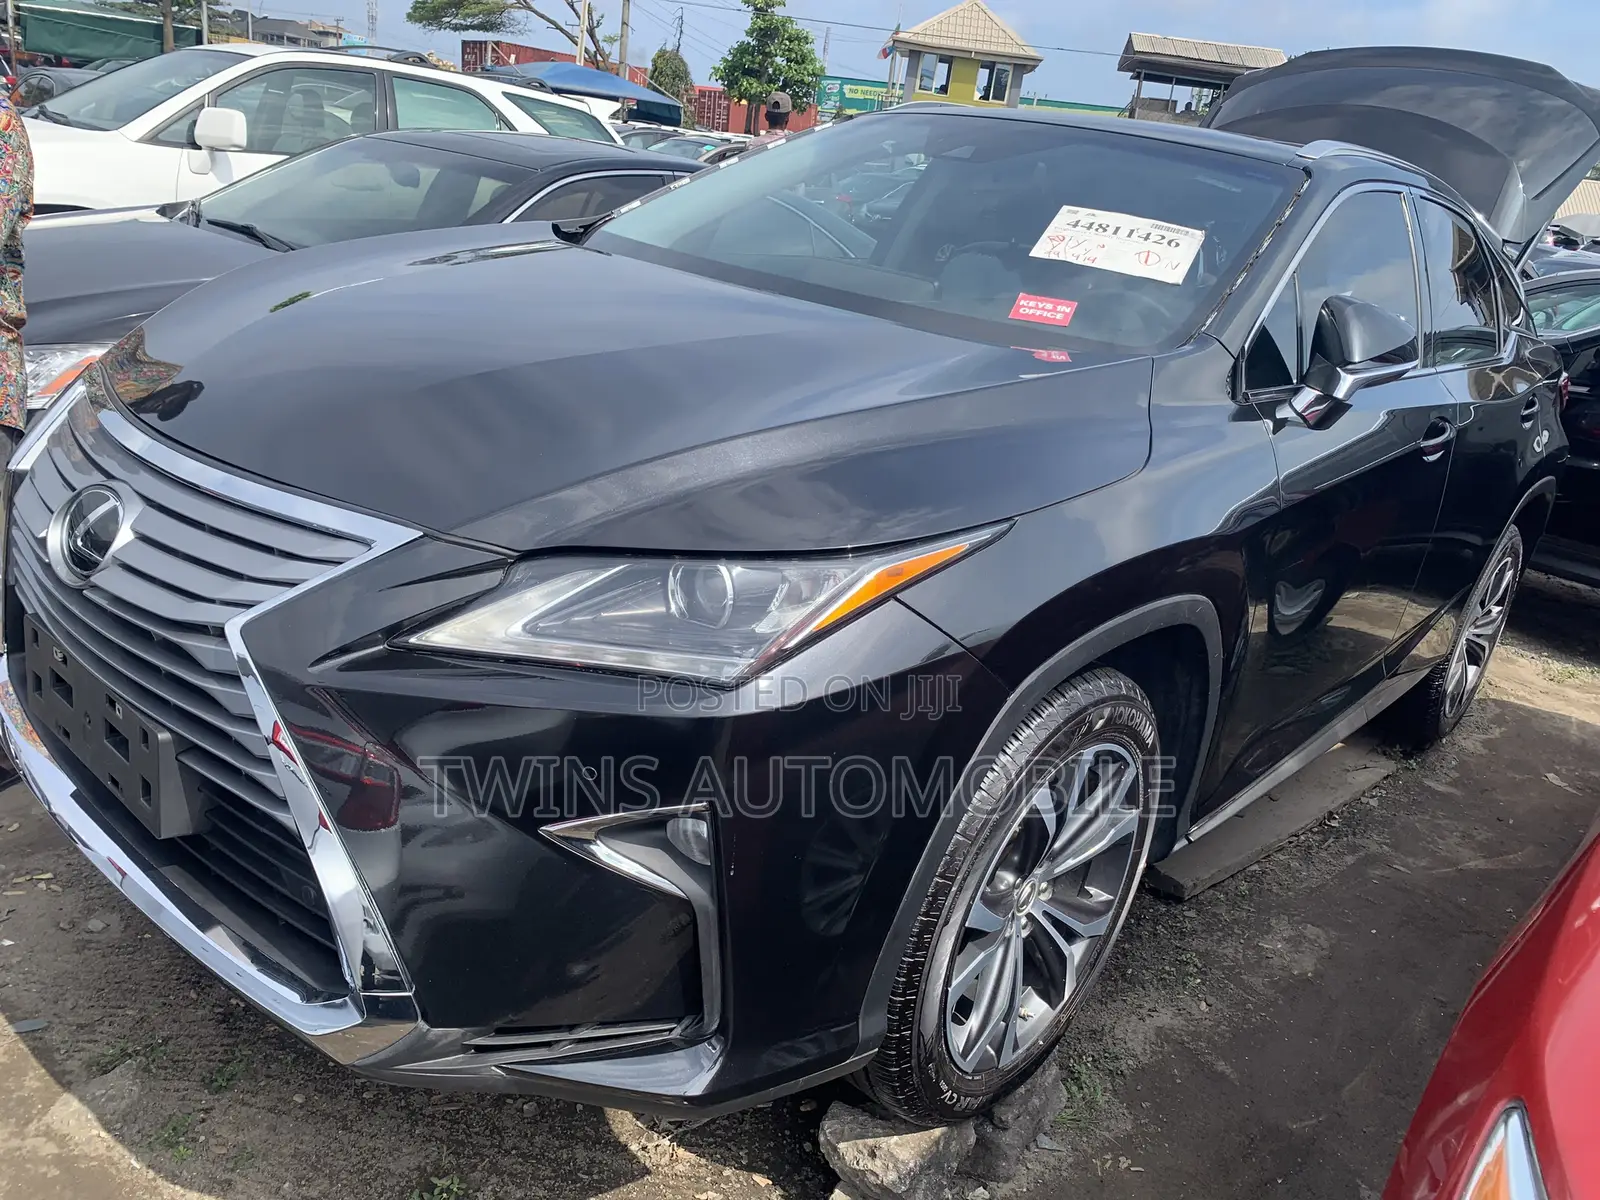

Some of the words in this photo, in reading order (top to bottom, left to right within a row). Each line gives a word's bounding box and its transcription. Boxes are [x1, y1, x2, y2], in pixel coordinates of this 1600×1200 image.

[1066, 219, 1181, 249] 44811426
[1019, 300, 1054, 310] KEYS
[1056, 305, 1072, 313] IN
[1019, 307, 1065, 320] OFFICE
[1111, 705, 1156, 748] YOKOHAMA
